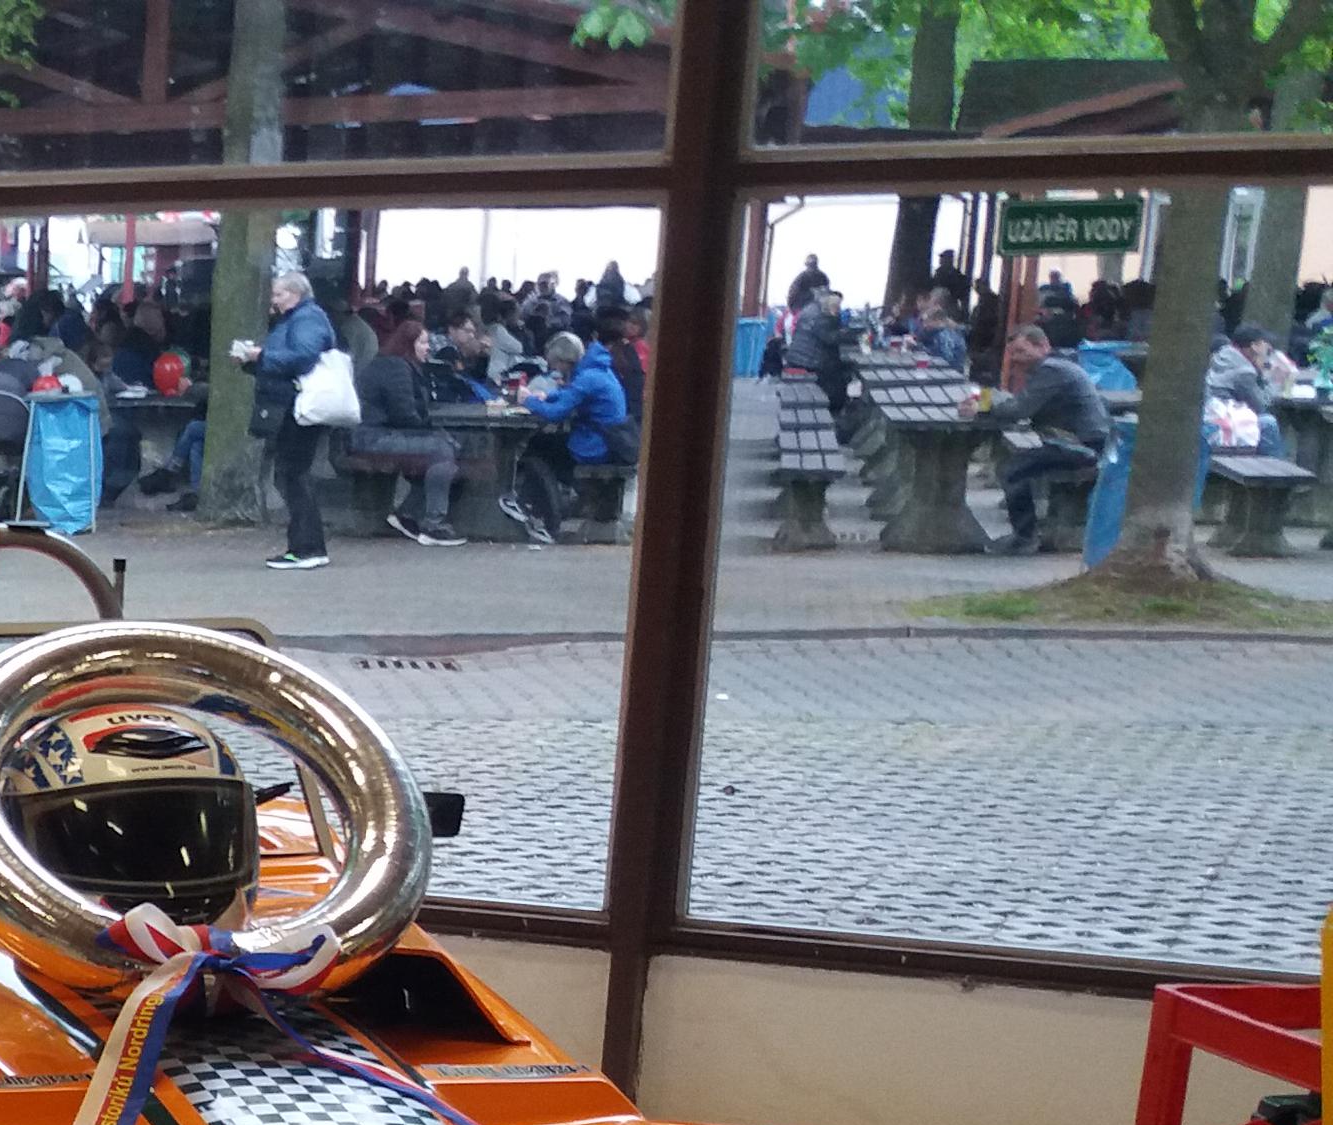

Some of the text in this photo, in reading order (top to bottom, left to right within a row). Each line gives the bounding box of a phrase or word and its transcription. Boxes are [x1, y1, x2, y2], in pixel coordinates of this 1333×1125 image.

[1084, 217, 1133, 242] VODY
[107, 713, 177, 725] uvex
[118, 992, 165, 1070] Nordring
